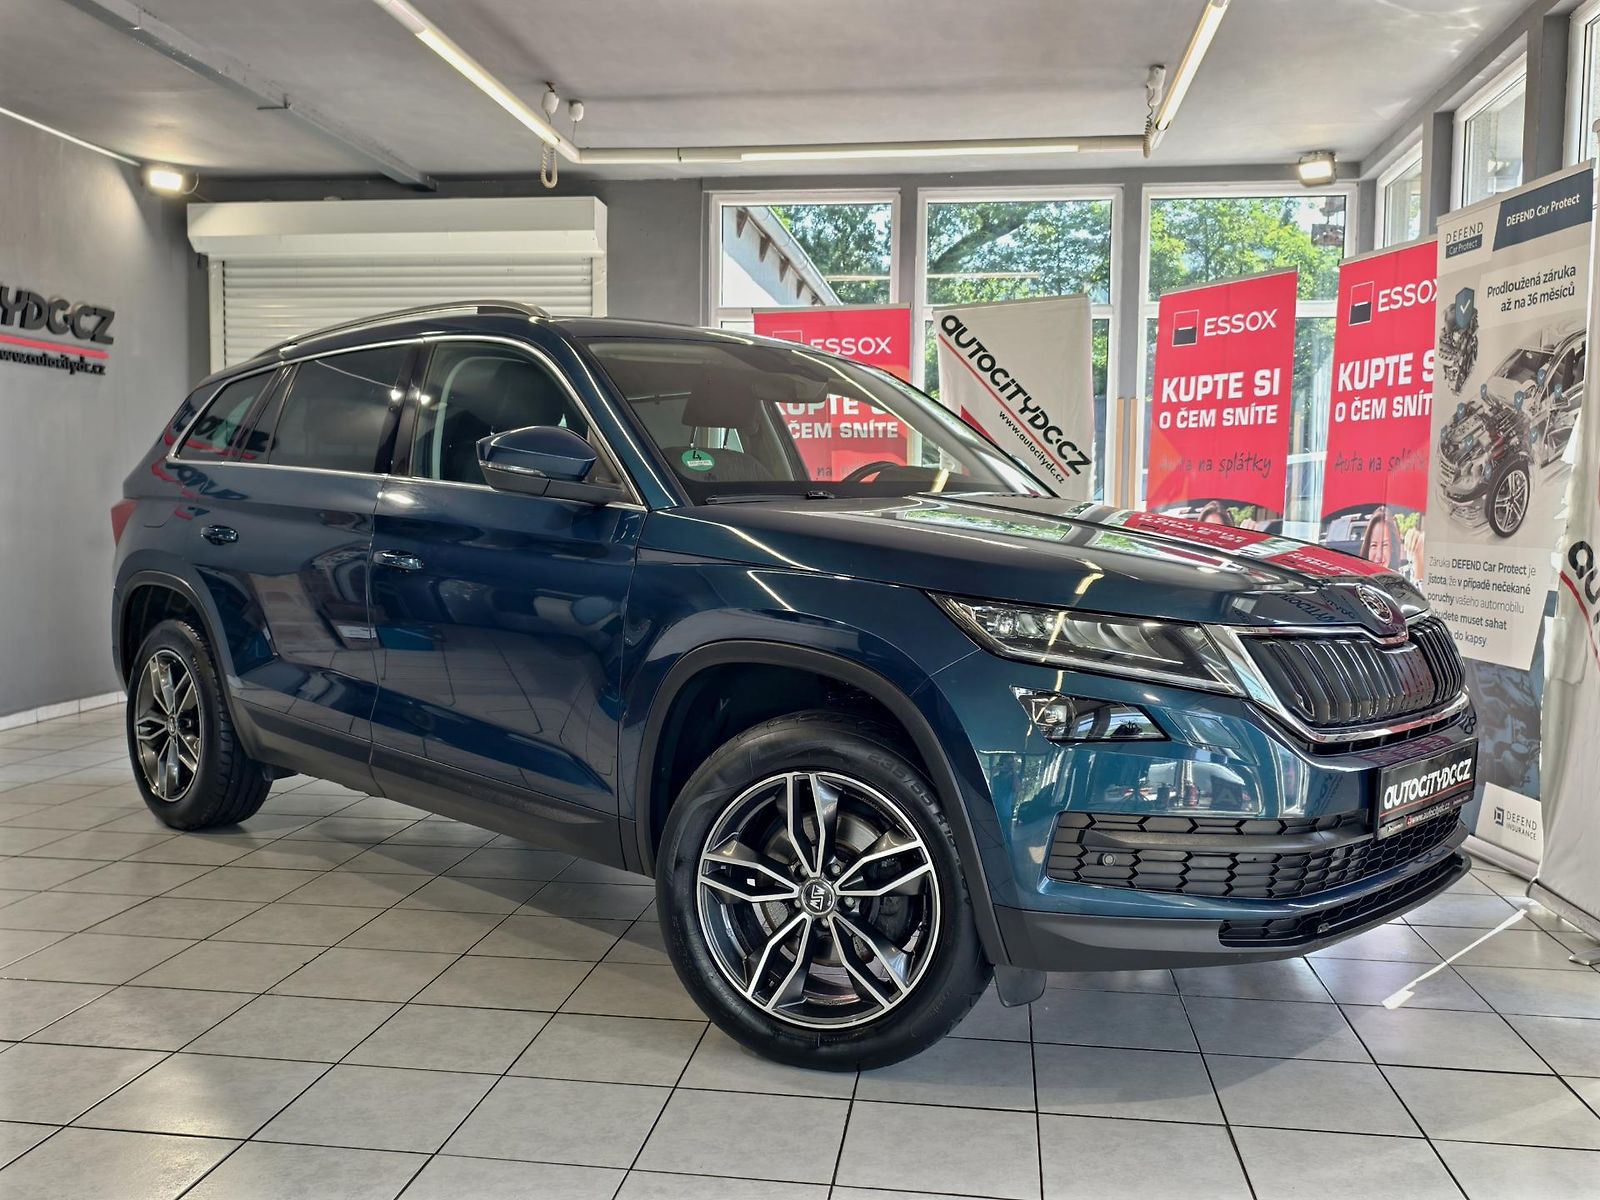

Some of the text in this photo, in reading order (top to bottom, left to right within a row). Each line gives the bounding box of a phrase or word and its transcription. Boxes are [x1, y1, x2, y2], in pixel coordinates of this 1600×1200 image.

[1506, 193, 1580, 226] DEFEND Car Protect
[1446, 222, 1483, 243] DEFEND
[1449, 239, 1478, 255] Car Protect
[1487, 265, 1576, 298] Prodloužená záruka
[1501, 281, 1575, 312] až na 36 měsíců
[1204, 309, 1279, 337] ESSOX
[0, 350, 106, 375] ww.autocitydc.cz
[1337, 349, 1434, 392] KUPTE S
[1161, 368, 1281, 403] KUPTE SI
[776, 393, 859, 416] UPTE
[1159, 403, 1278, 429] O ČEM SNÍTE
[1335, 389, 1432, 423] O ČEM SNÍT
[788, 419, 898, 439] ČEM SNÍTE
[1000, 411, 1065, 484] www.autocitydc.cz
[1199, 457, 1213, 472] na
[1219, 450, 1272, 479] splátky
[1334, 452, 1363, 474] Auta
[1369, 456, 1381, 473] na
[1452, 558, 1481, 571] DEFEND
[1483, 561, 1496, 572] Car
[1499, 563, 1527, 576] Protect
[1527, 565, 1536, 578] je
[1457, 579, 1463, 587] v
[1463, 577, 1490, 591] případě
[1492, 581, 1531, 595] nečekané
[1427, 592, 1524, 613] poruchy vašeho automobilu
[1433, 608, 1507, 631] budete muset sahat
[1454, 630, 1463, 640] do
[1506, 811, 1538, 831] DEFEND
[1506, 823, 1537, 840] INSURANCE
